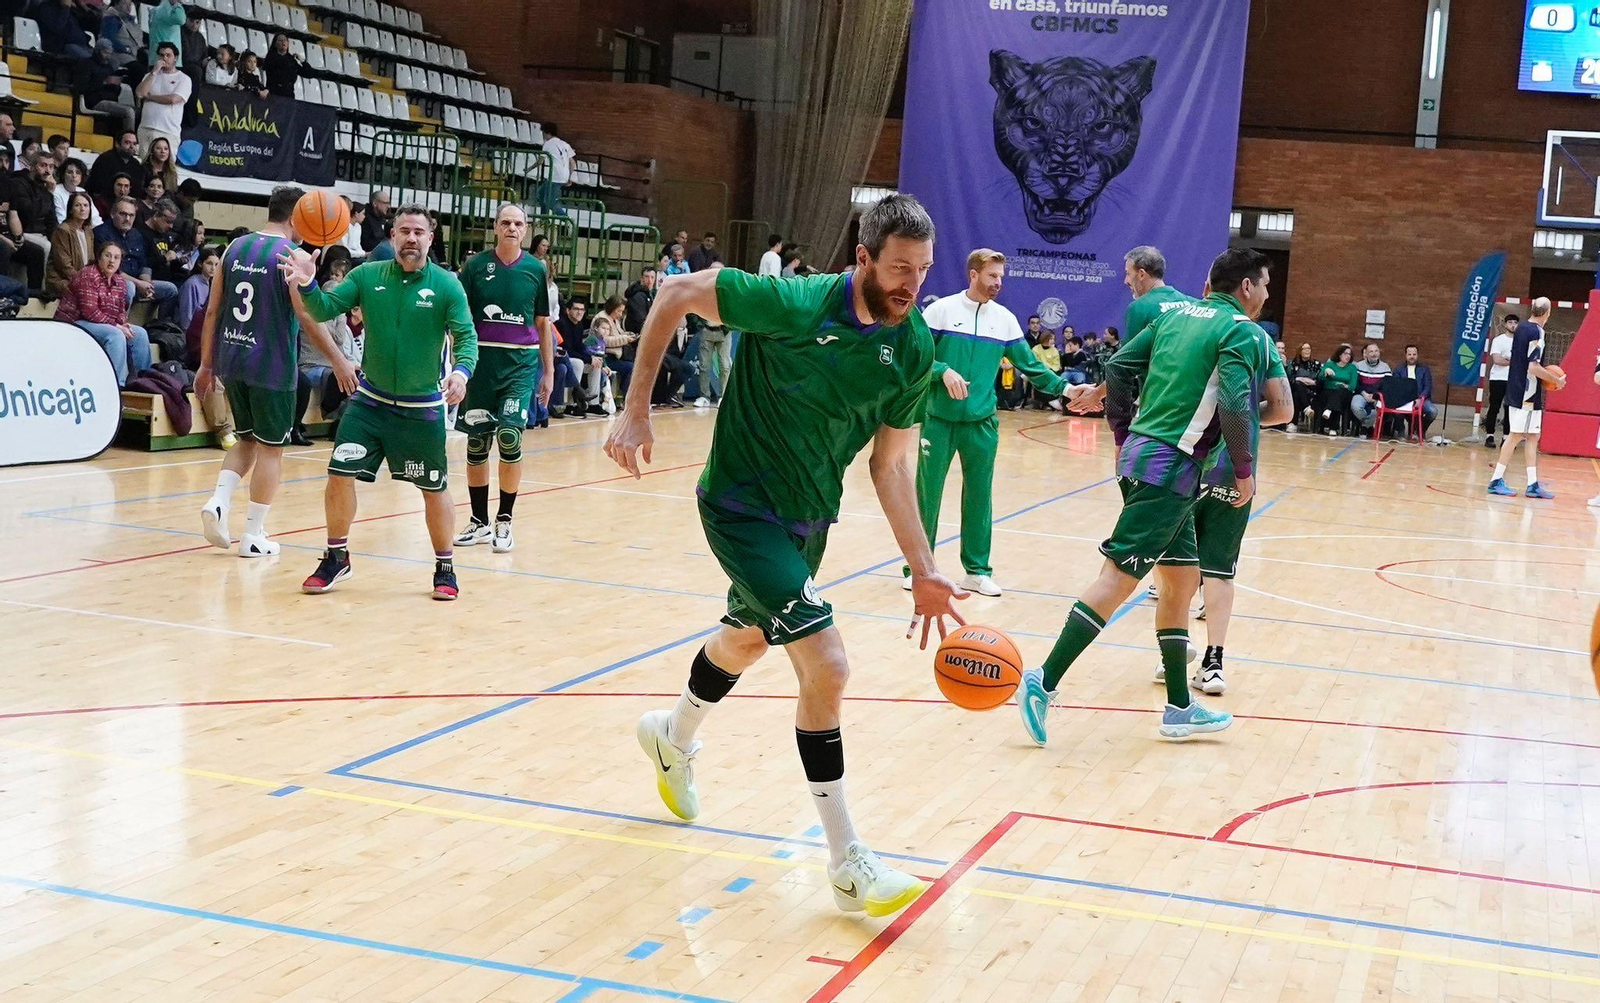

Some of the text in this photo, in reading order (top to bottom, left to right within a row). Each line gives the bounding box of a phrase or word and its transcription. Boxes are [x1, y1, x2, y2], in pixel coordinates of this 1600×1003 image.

[989, 0, 1168, 17] en casa, triunfamos
[1030, 15, 1119, 34] CBFMCS
[1547, 9, 1558, 26] 0
[233, 143, 262, 155] Euopa
[1016, 248, 1097, 261] TRICAMPEONAS
[1008, 269, 1103, 283] EHF EUROPEAN CUP 2021
[232, 281, 254, 323] 3
[1461, 275, 1483, 340] Fundación
[500, 312, 525, 322] Unicaja
[1470, 295, 1489, 341] Unicaja
[1210, 492, 1237, 503] MALA
[1212, 486, 1228, 496] DEL
[1229, 490, 1241, 498] SO
[944, 653, 1001, 680] Wilson
